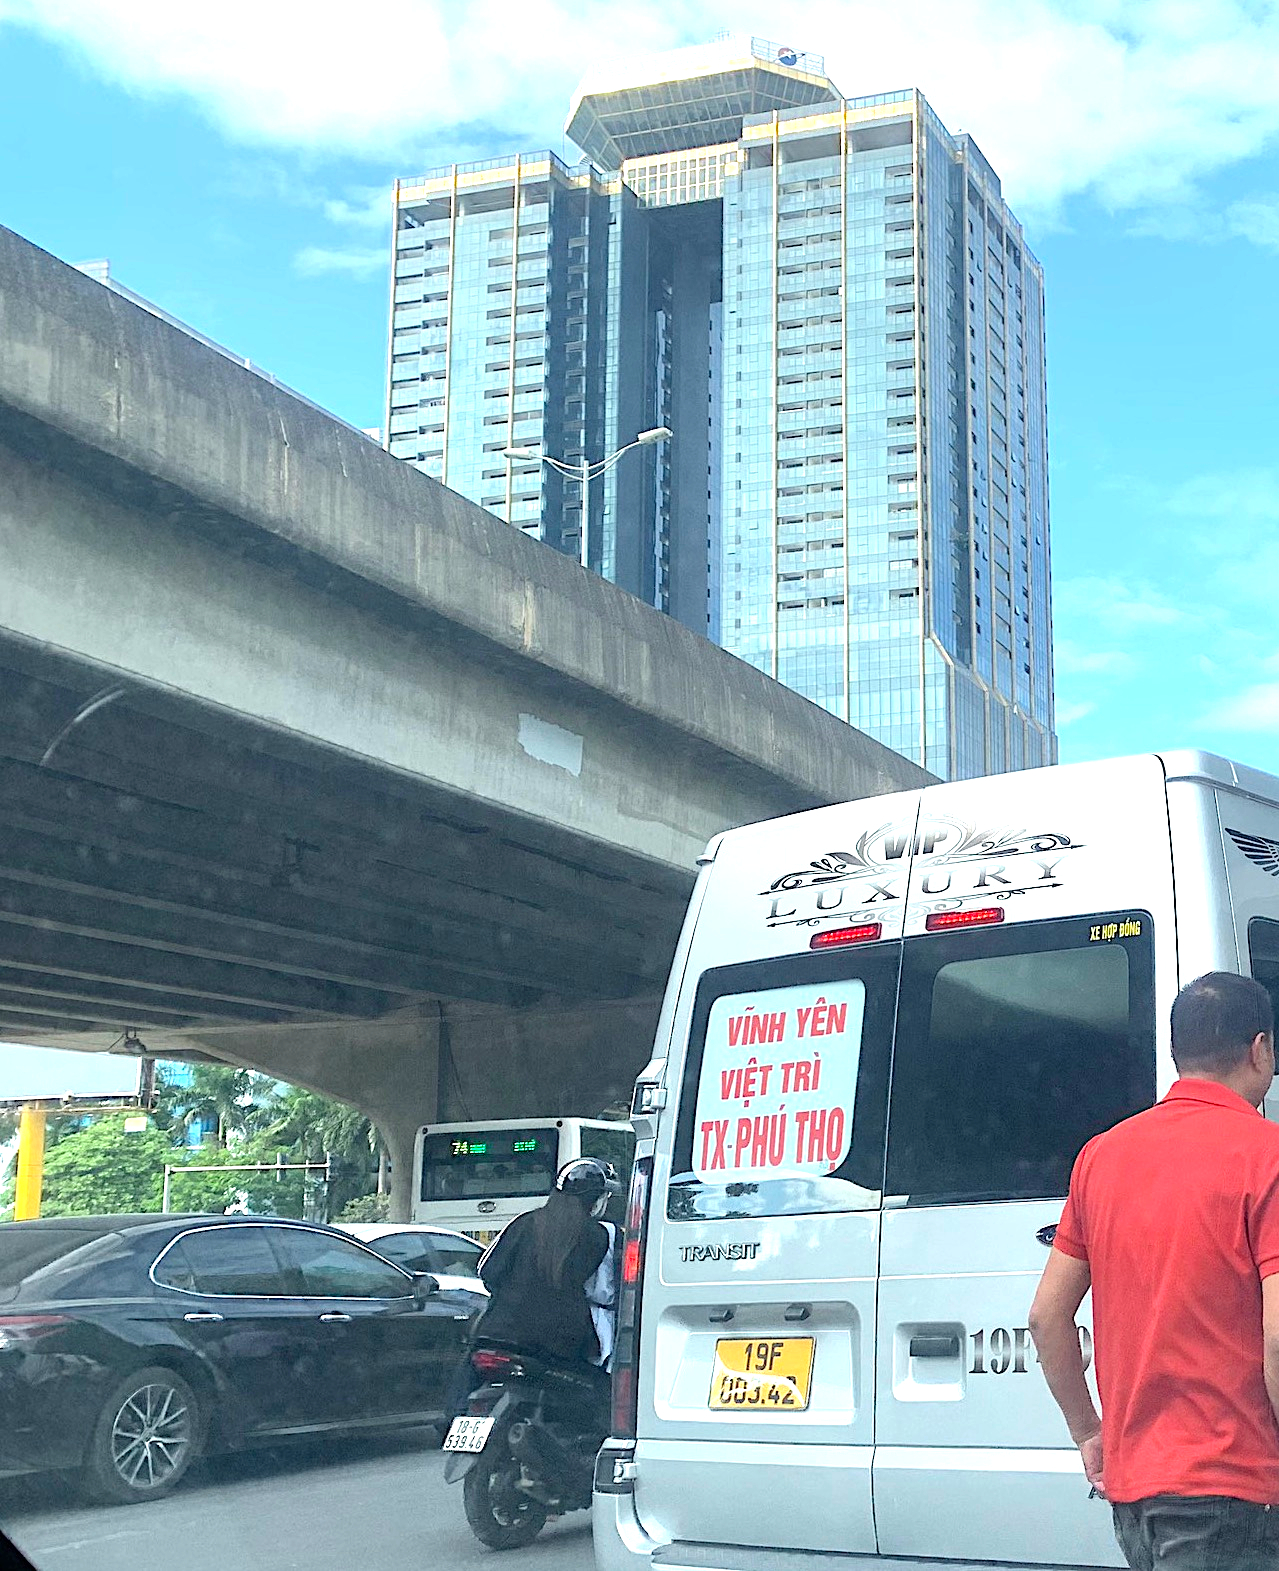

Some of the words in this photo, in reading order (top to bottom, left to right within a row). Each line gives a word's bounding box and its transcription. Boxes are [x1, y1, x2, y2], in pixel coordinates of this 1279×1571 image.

[884, 829, 949, 861] VIP
[765, 855, 1067, 920] LUXURY
[1089, 925, 1101, 942] XE
[728, 1006, 787, 1046] VĨNH
[796, 996, 848, 1038] YÊN
[720, 1056, 774, 1108] VIỆT
[781, 1051, 822, 1094] TRÌ
[451, 1141, 468, 1155] 74
[700, 1103, 788, 1171] TX-PHÚ
[795, 1106, 845, 1171] THỌ
[678, 1241, 762, 1263] TRANSIT
[742, 1342, 784, 1372] 19F
[445, 1434, 485, 1449] 539.46
